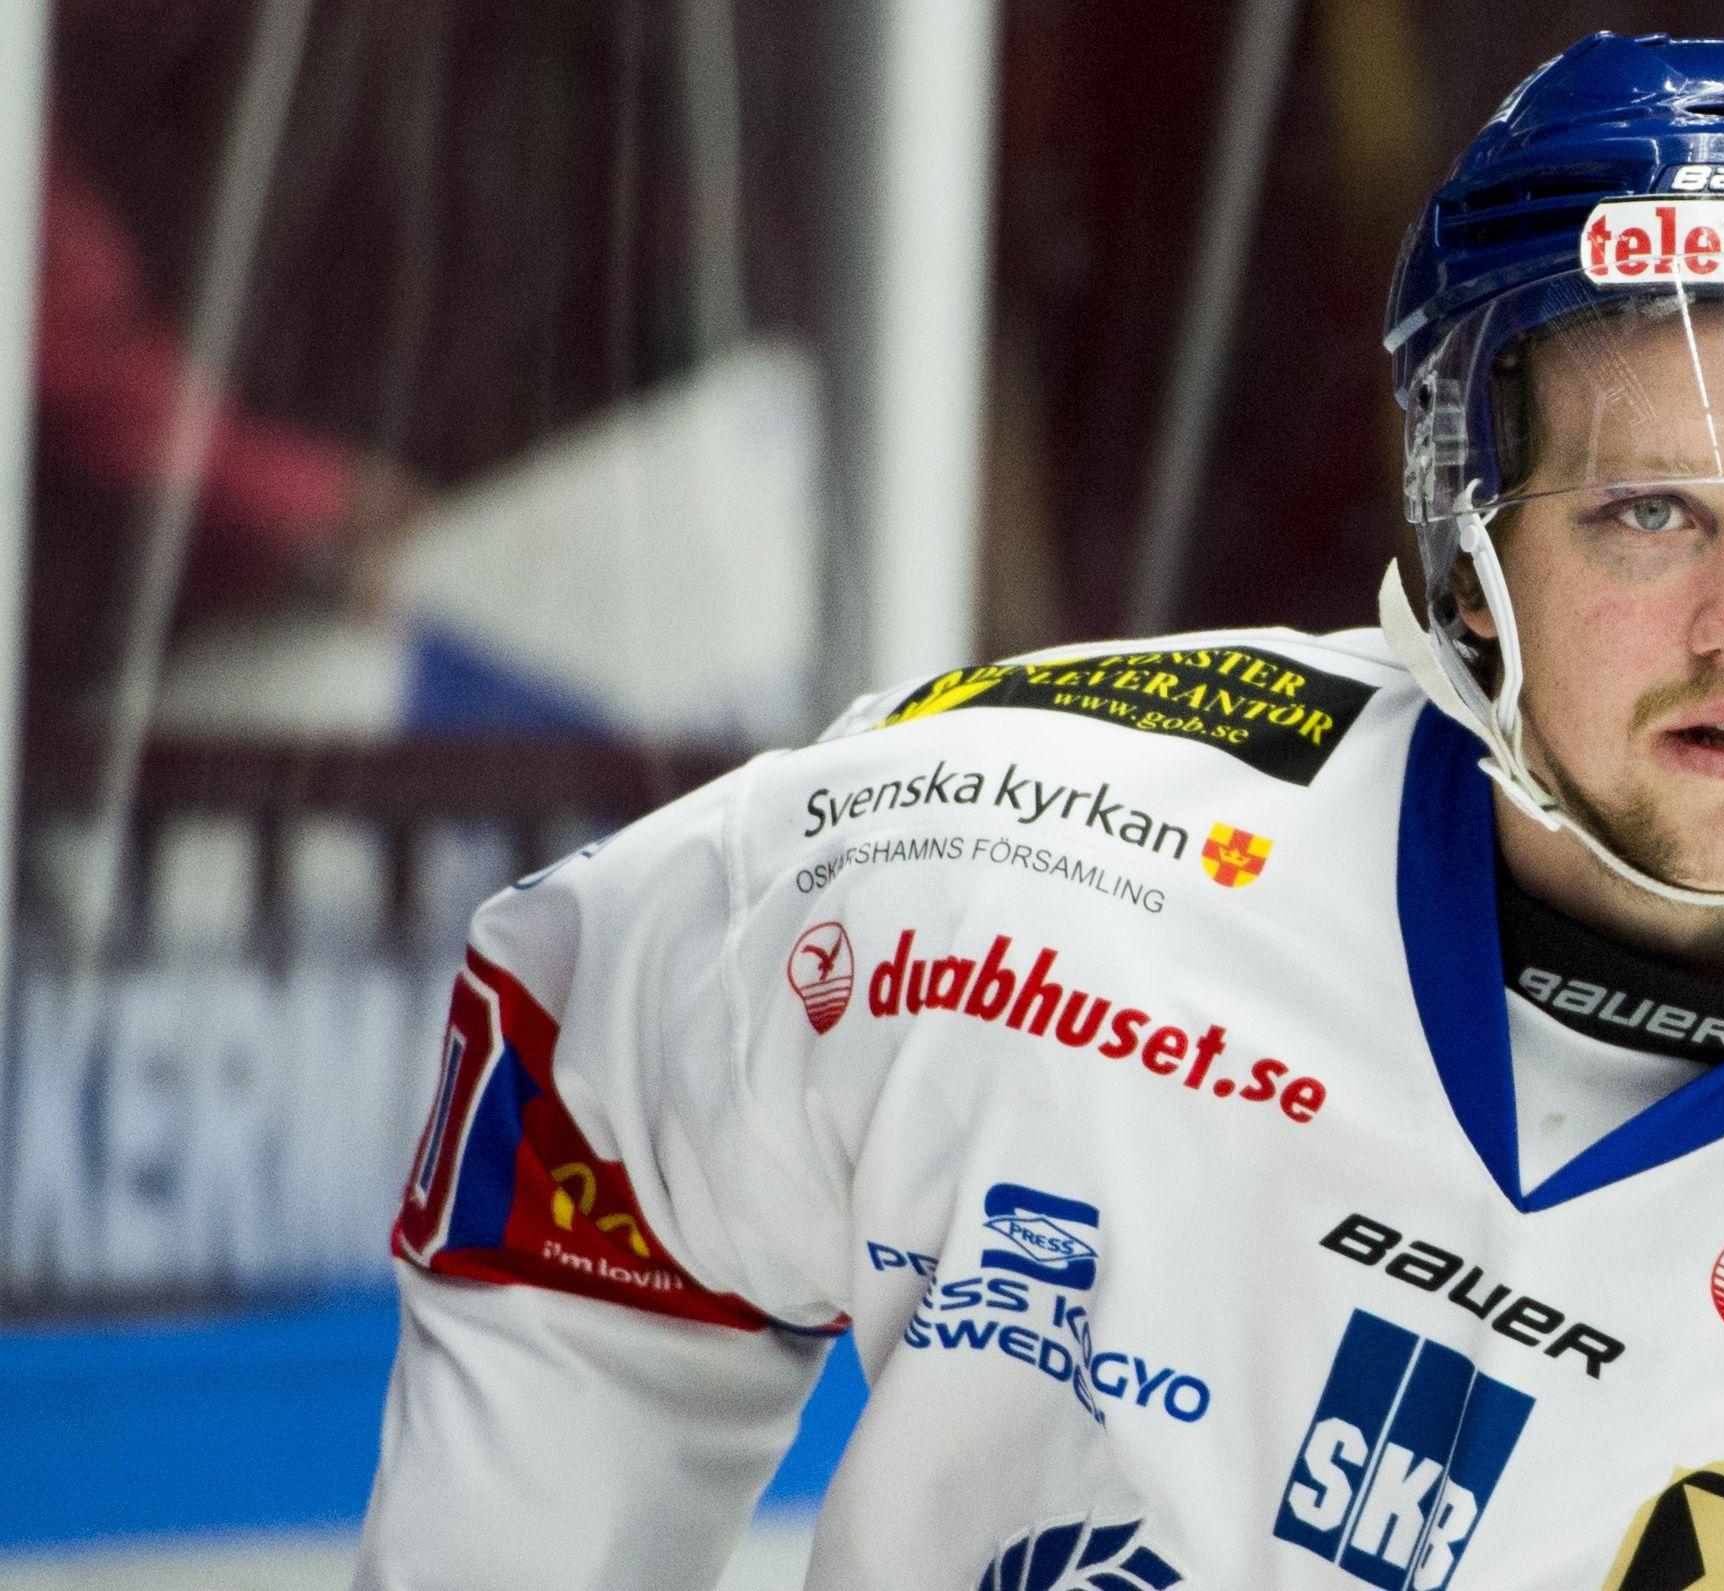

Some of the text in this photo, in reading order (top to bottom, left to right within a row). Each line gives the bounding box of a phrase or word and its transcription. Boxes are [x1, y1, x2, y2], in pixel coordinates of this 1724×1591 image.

[803, 760, 1190, 860] Svenska kyrkan
[971, 836, 1166, 913] FÖRSAMLING
[1009, 1219, 1075, 1255] PRESS
[1288, 1416, 1479, 1591] SKB
